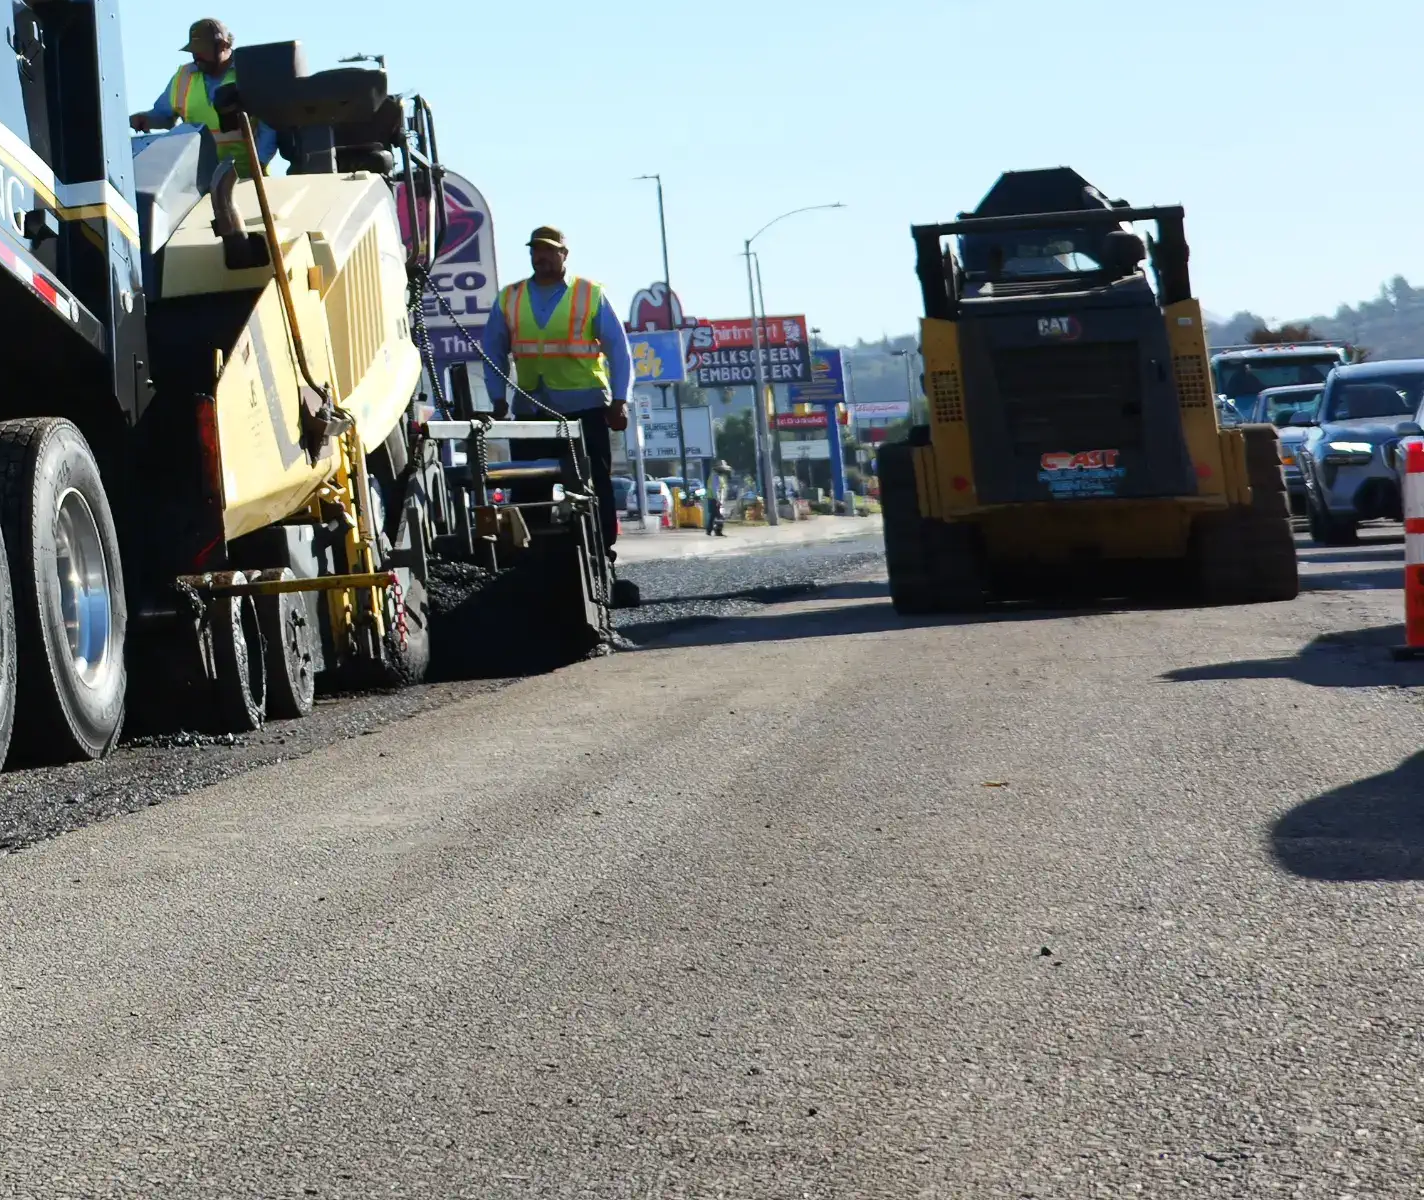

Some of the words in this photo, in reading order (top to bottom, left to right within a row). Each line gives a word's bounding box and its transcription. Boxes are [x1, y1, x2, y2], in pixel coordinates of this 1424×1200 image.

[421, 295, 492, 317] ELL
[1037, 316, 1069, 336] CAT
[700, 363, 804, 383] EMBROERY
